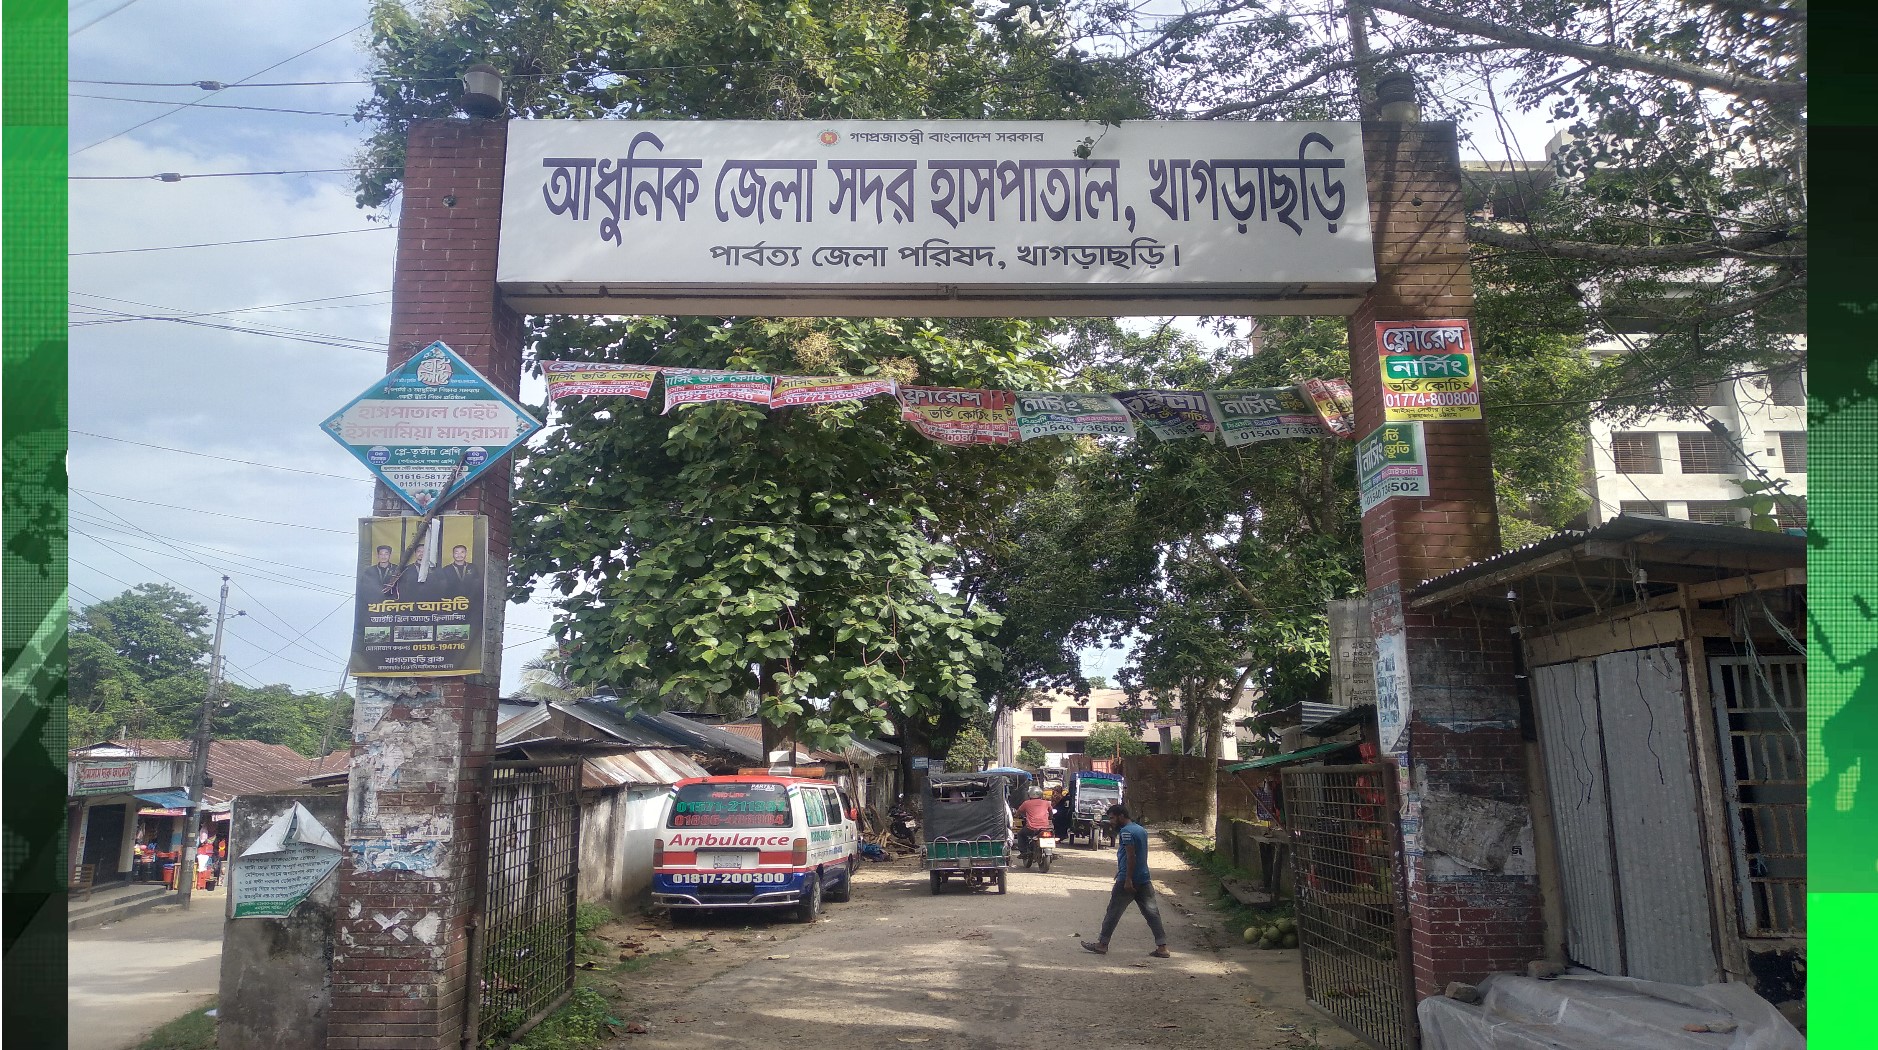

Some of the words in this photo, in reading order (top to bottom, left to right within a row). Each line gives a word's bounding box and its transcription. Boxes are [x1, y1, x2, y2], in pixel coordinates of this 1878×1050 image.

[850, 128, 925, 145] গণপ্রজাতন্ত্রী
[928, 132, 992, 144] বাংলাদেশ
[995, 132, 1045, 143] সরকার
[542, 131, 703, 248] আধুনিক
[715, 159, 818, 225] জেলা
[827, 160, 917, 225] সদর
[928, 158, 1137, 233] হাসপাতাল,
[1149, 131, 1347, 237] খাগড়াছড়ি
[709, 241, 802, 267] পার্বত্য
[811, 246, 889, 268] জেলা
[898, 237, 1007, 270] পরিষদ,
[1382, 325, 1465, 353] ফ্লোরেন্স
[1389, 355, 1468, 377] নার্সিং
[1387, 378, 1420, 392] ভর্তি
[1425, 377, 1473, 392] কোচিং
[1220, 393, 1281, 415] নার্সিং
[1385, 391, 1478, 407] 01774-800800
[358, 404, 448, 420] হাসপাতাল
[452, 402, 499, 420] গেইট
[345, 421, 434, 441] ইসলামিয়া
[1080, 424, 1126, 434] 736502
[1240, 428, 1281, 440] 01540
[367, 599, 415, 613] খলিল
[416, 595, 470, 612] আইটি
[668, 832, 790, 847] Ambulance
[672, 872, 785, 884] 01817-200300
